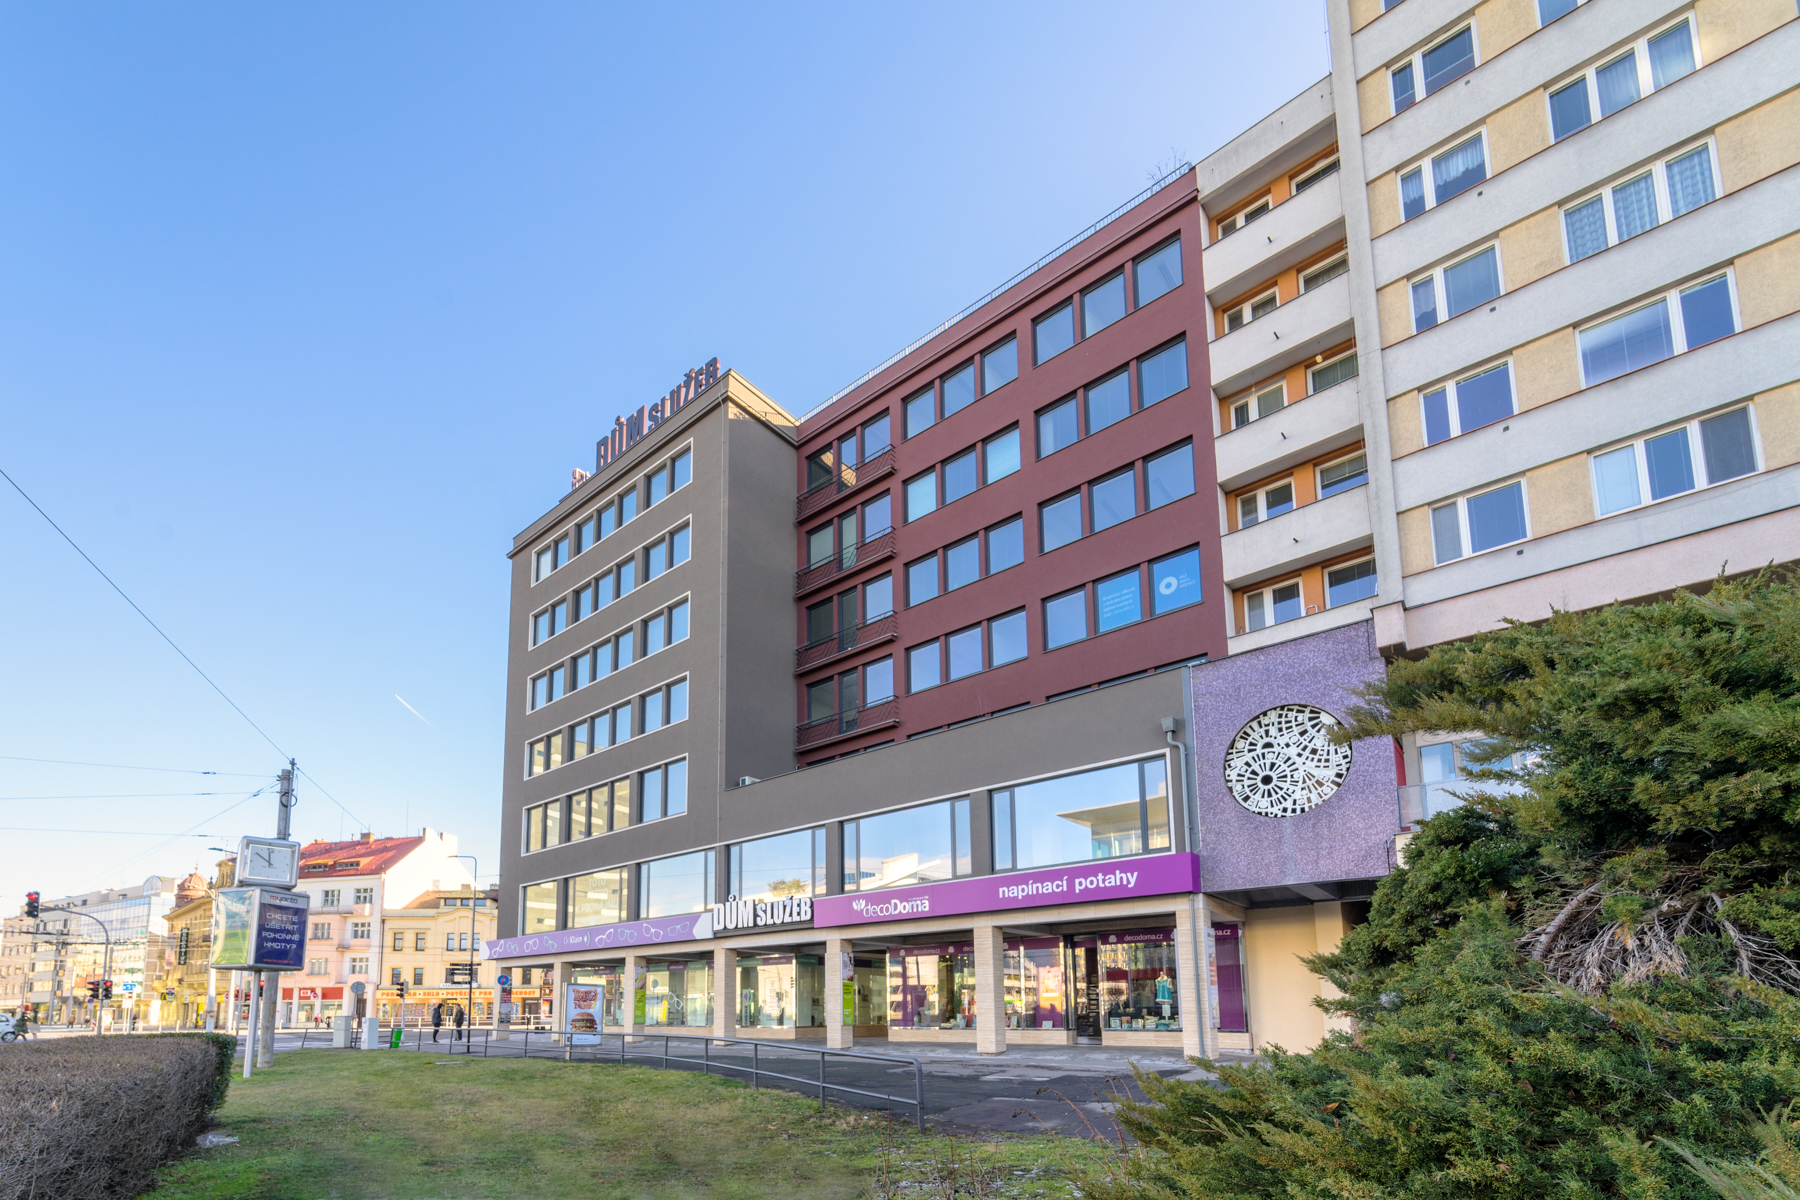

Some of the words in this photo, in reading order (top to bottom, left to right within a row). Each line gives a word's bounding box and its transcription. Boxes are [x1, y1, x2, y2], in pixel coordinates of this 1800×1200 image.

[999, 876, 1069, 899] napínací
[1075, 870, 1138, 893] potahy
[713, 894, 754, 930] DŮM
[756, 895, 812, 926] SLUŽEB
[863, 899, 929, 917] decoDoma
[266, 912, 298, 922] CHCETE
[1124, 933, 1163, 942] decodoma.cz
[263, 941, 297, 950] HMOTY?
